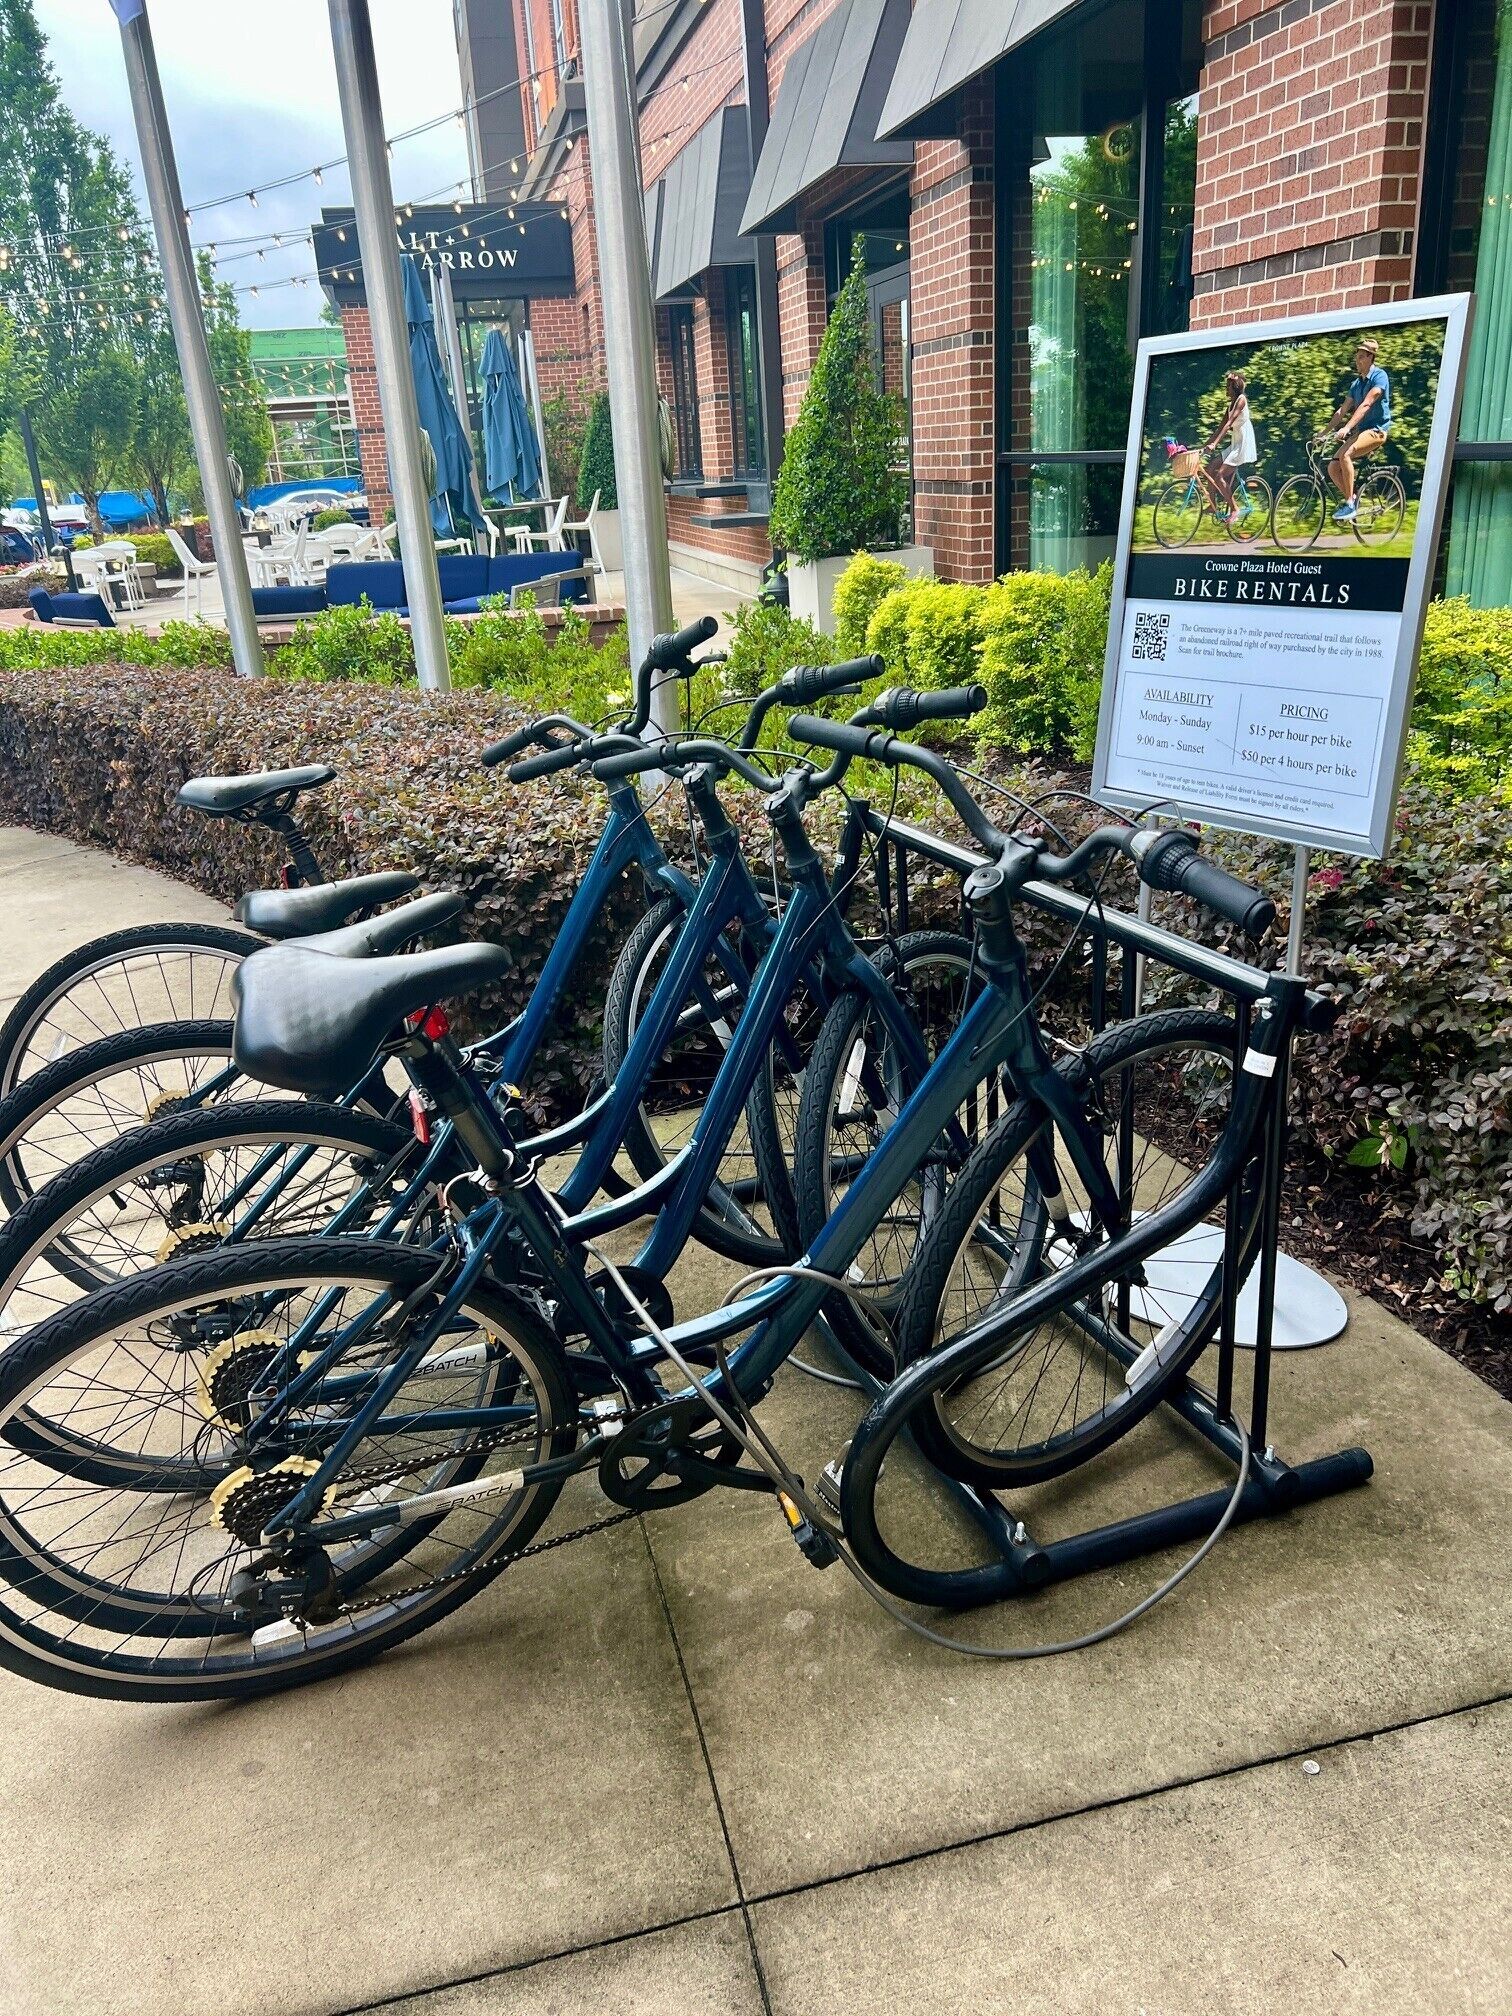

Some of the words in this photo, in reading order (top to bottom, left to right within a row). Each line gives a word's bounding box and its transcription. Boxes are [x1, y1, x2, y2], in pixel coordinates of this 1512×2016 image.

[396, 232, 439, 249] ALT
[409, 249, 518, 270] ARROW
[1205, 559, 1239, 572] Crowne
[1240, 560, 1264, 573] Plaza
[1266, 561, 1292, 574] Hotel
[1293, 562, 1322, 575] Guest
[1174, 578, 1229, 598] BIKE
[1235, 580, 1351, 604] RENTALS
[1180, 623, 1193, 632] The
[1192, 624, 1226, 636] Greeneway
[1227, 626, 1233, 635] is
[1239, 627, 1248, 636] 7+
[1248, 628, 1262, 637] mile
[1263, 629, 1284, 640] paved
[1284, 631, 1323, 642] recreational
[1324, 633, 1338, 643] trail
[1339, 634, 1354, 644] that
[1354, 635, 1381, 646] follows
[1178, 645, 1192, 655] Scan
[1193, 646, 1202, 655] for
[1202, 648, 1215, 656] trail
[1216, 648, 1244, 659] brochure.
[1187, 635, 1219, 645] abandoned
[1219, 637, 1243, 648] railroad
[1244, 639, 1259, 650] right
[1260, 640, 1268, 649] of
[1268, 642, 1283, 653] way
[1282, 642, 1316, 653] purchased
[1317, 644, 1327, 656] by
[1327, 646, 1339, 655] the
[1339, 646, 1354, 658] city
[1354, 647, 1362, 657] in
[1364, 648, 1385, 659] 1988.
[1144, 688, 1214, 706] AVAILABILITY
[1139, 709, 1173, 726] Monday
[1180, 714, 1212, 731] Sunday
[1280, 703, 1329, 720] PRICING
[1136, 733, 1155, 747] 9:00
[1156, 739, 1169, 749] am
[1176, 740, 1205, 754] Sunset
[1248, 723, 1267, 737] $15
[1268, 728, 1285, 740] per
[1286, 728, 1310, 743] hour
[1310, 735, 1328, 747] per
[1329, 734, 1352, 749] bike
[1241, 749, 1259, 763] $50
[1260, 755, 1276, 766] per
[1277, 755, 1285, 766] 4
[1286, 756, 1314, 772] hours
[1315, 764, 1333, 776] per
[1334, 763, 1358, 779] bike
[422, 1354, 477, 1375] BATCH
